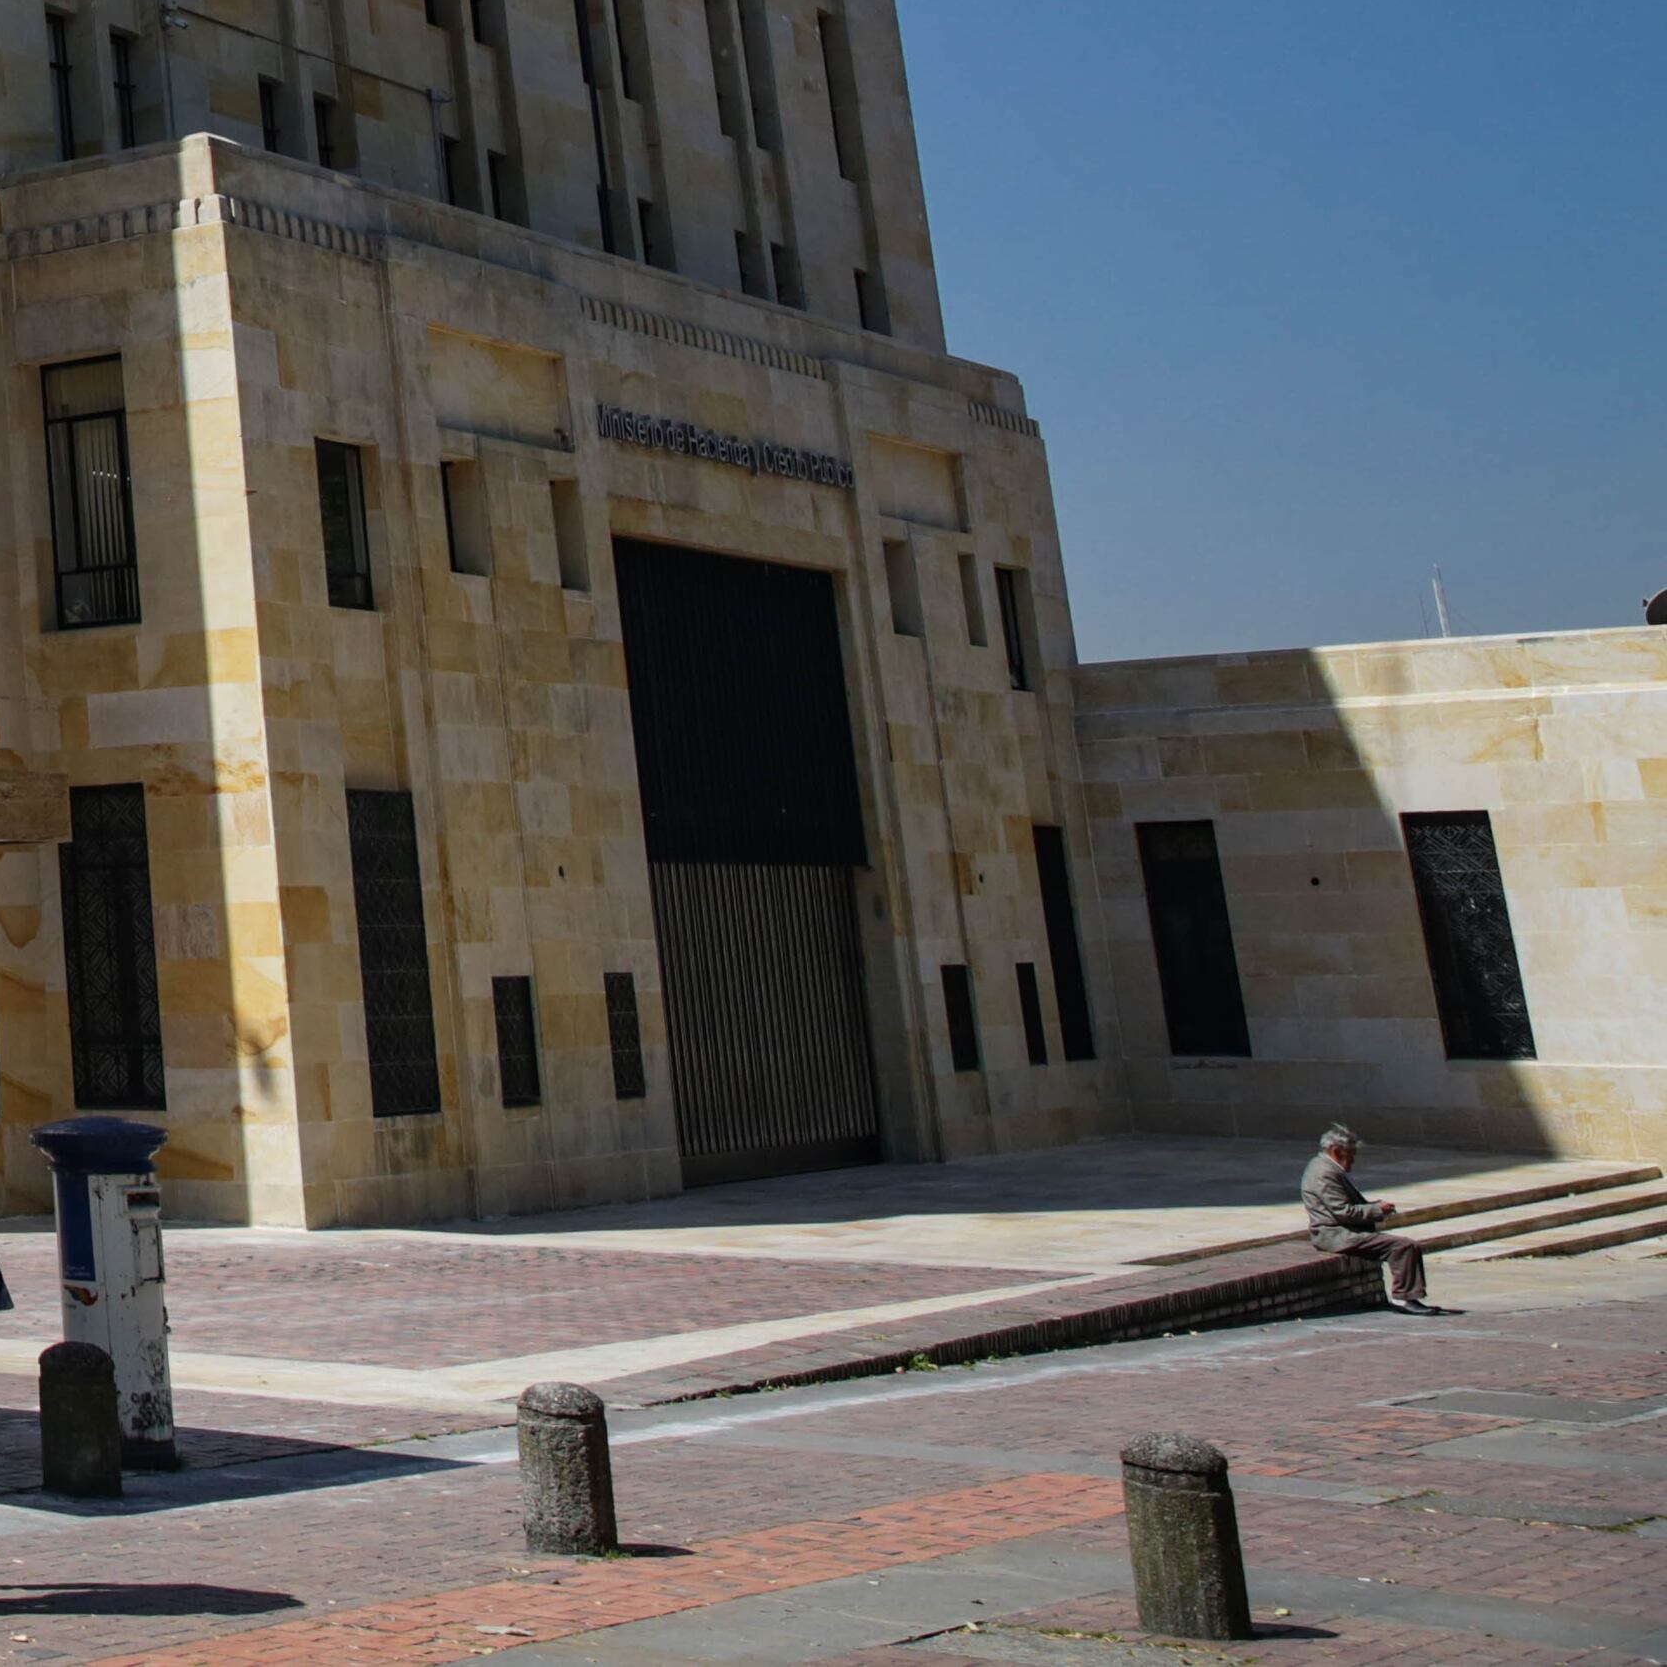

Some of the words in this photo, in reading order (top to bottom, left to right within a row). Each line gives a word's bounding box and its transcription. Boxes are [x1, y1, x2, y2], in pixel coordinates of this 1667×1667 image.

[596, 401, 665, 447] Ministerio
[665, 421, 685, 452] de
[686, 423, 751, 467] Hacienda
[751, 444, 761, 478] y
